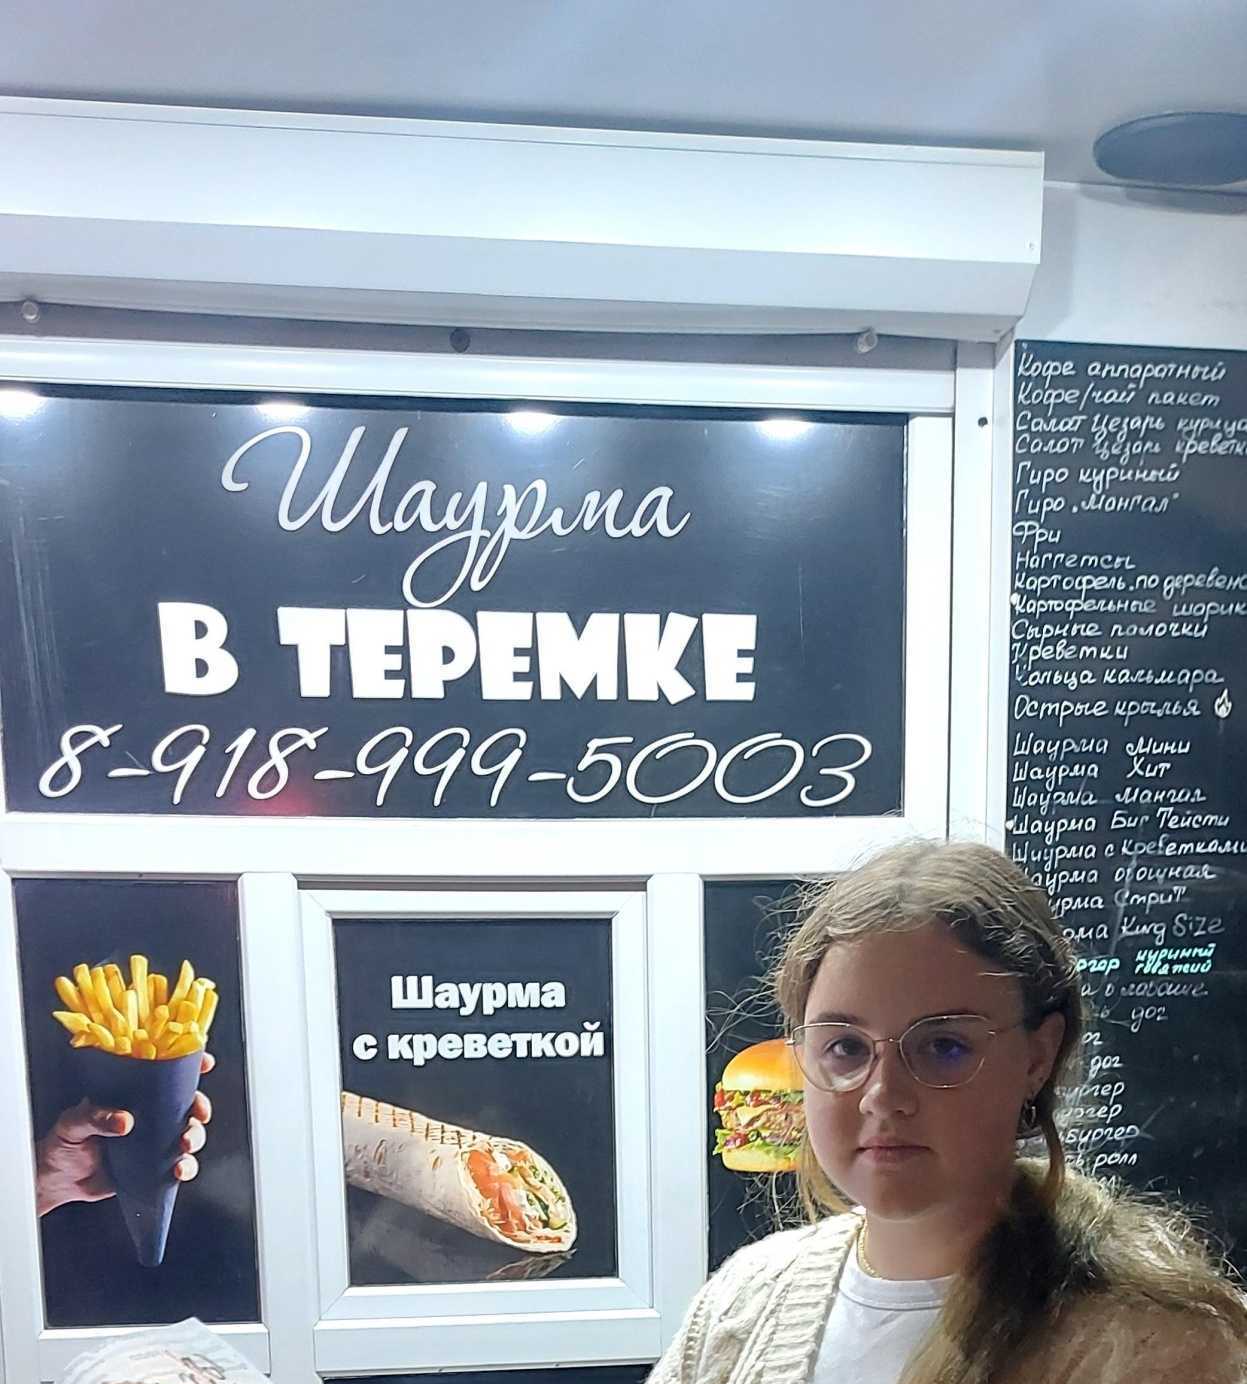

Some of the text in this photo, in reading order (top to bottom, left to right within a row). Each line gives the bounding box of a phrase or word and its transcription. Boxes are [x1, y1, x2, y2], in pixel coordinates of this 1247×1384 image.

[1018, 354, 1226, 389] Кофе аппаратный
[1148, 391, 1220, 407] пакет
[1016, 461, 1180, 494] Гиро куриный
[222, 425, 690, 608] Шаурма
[1014, 489, 1066, 523] Гиро
[1012, 520, 1062, 553] Фри
[1015, 551, 1136, 571] Наггетсы
[1013, 594, 1157, 620] Картофельные
[1011, 619, 1102, 647] Сырные
[157, 601, 758, 705] В ТЕРЕМКЕ
[1011, 639, 1129, 670] Креветки
[1102, 668, 1225, 693] кальмара
[1014, 695, 1202, 728] Острые крылья
[1013, 732, 1191, 761] Шаурма Мини
[37, 722, 873, 809] 8-918-999-5003
[1012, 755, 1172, 792] Шаурма Хит
[1012, 785, 1098, 815] Шаурма
[1012, 814, 1096, 844] Шаурма
[1156, 806, 1230, 830] Тейсти
[1024, 867, 1098, 895] аурма
[1050, 897, 1105, 920] урма
[390, 975, 567, 1017] Шаурма
[352, 1021, 605, 1067] с креветкой
[1081, 1031, 1104, 1046] ог
[1089, 1055, 1123, 1079] дог
[1092, 1152, 1139, 1175] ролл
